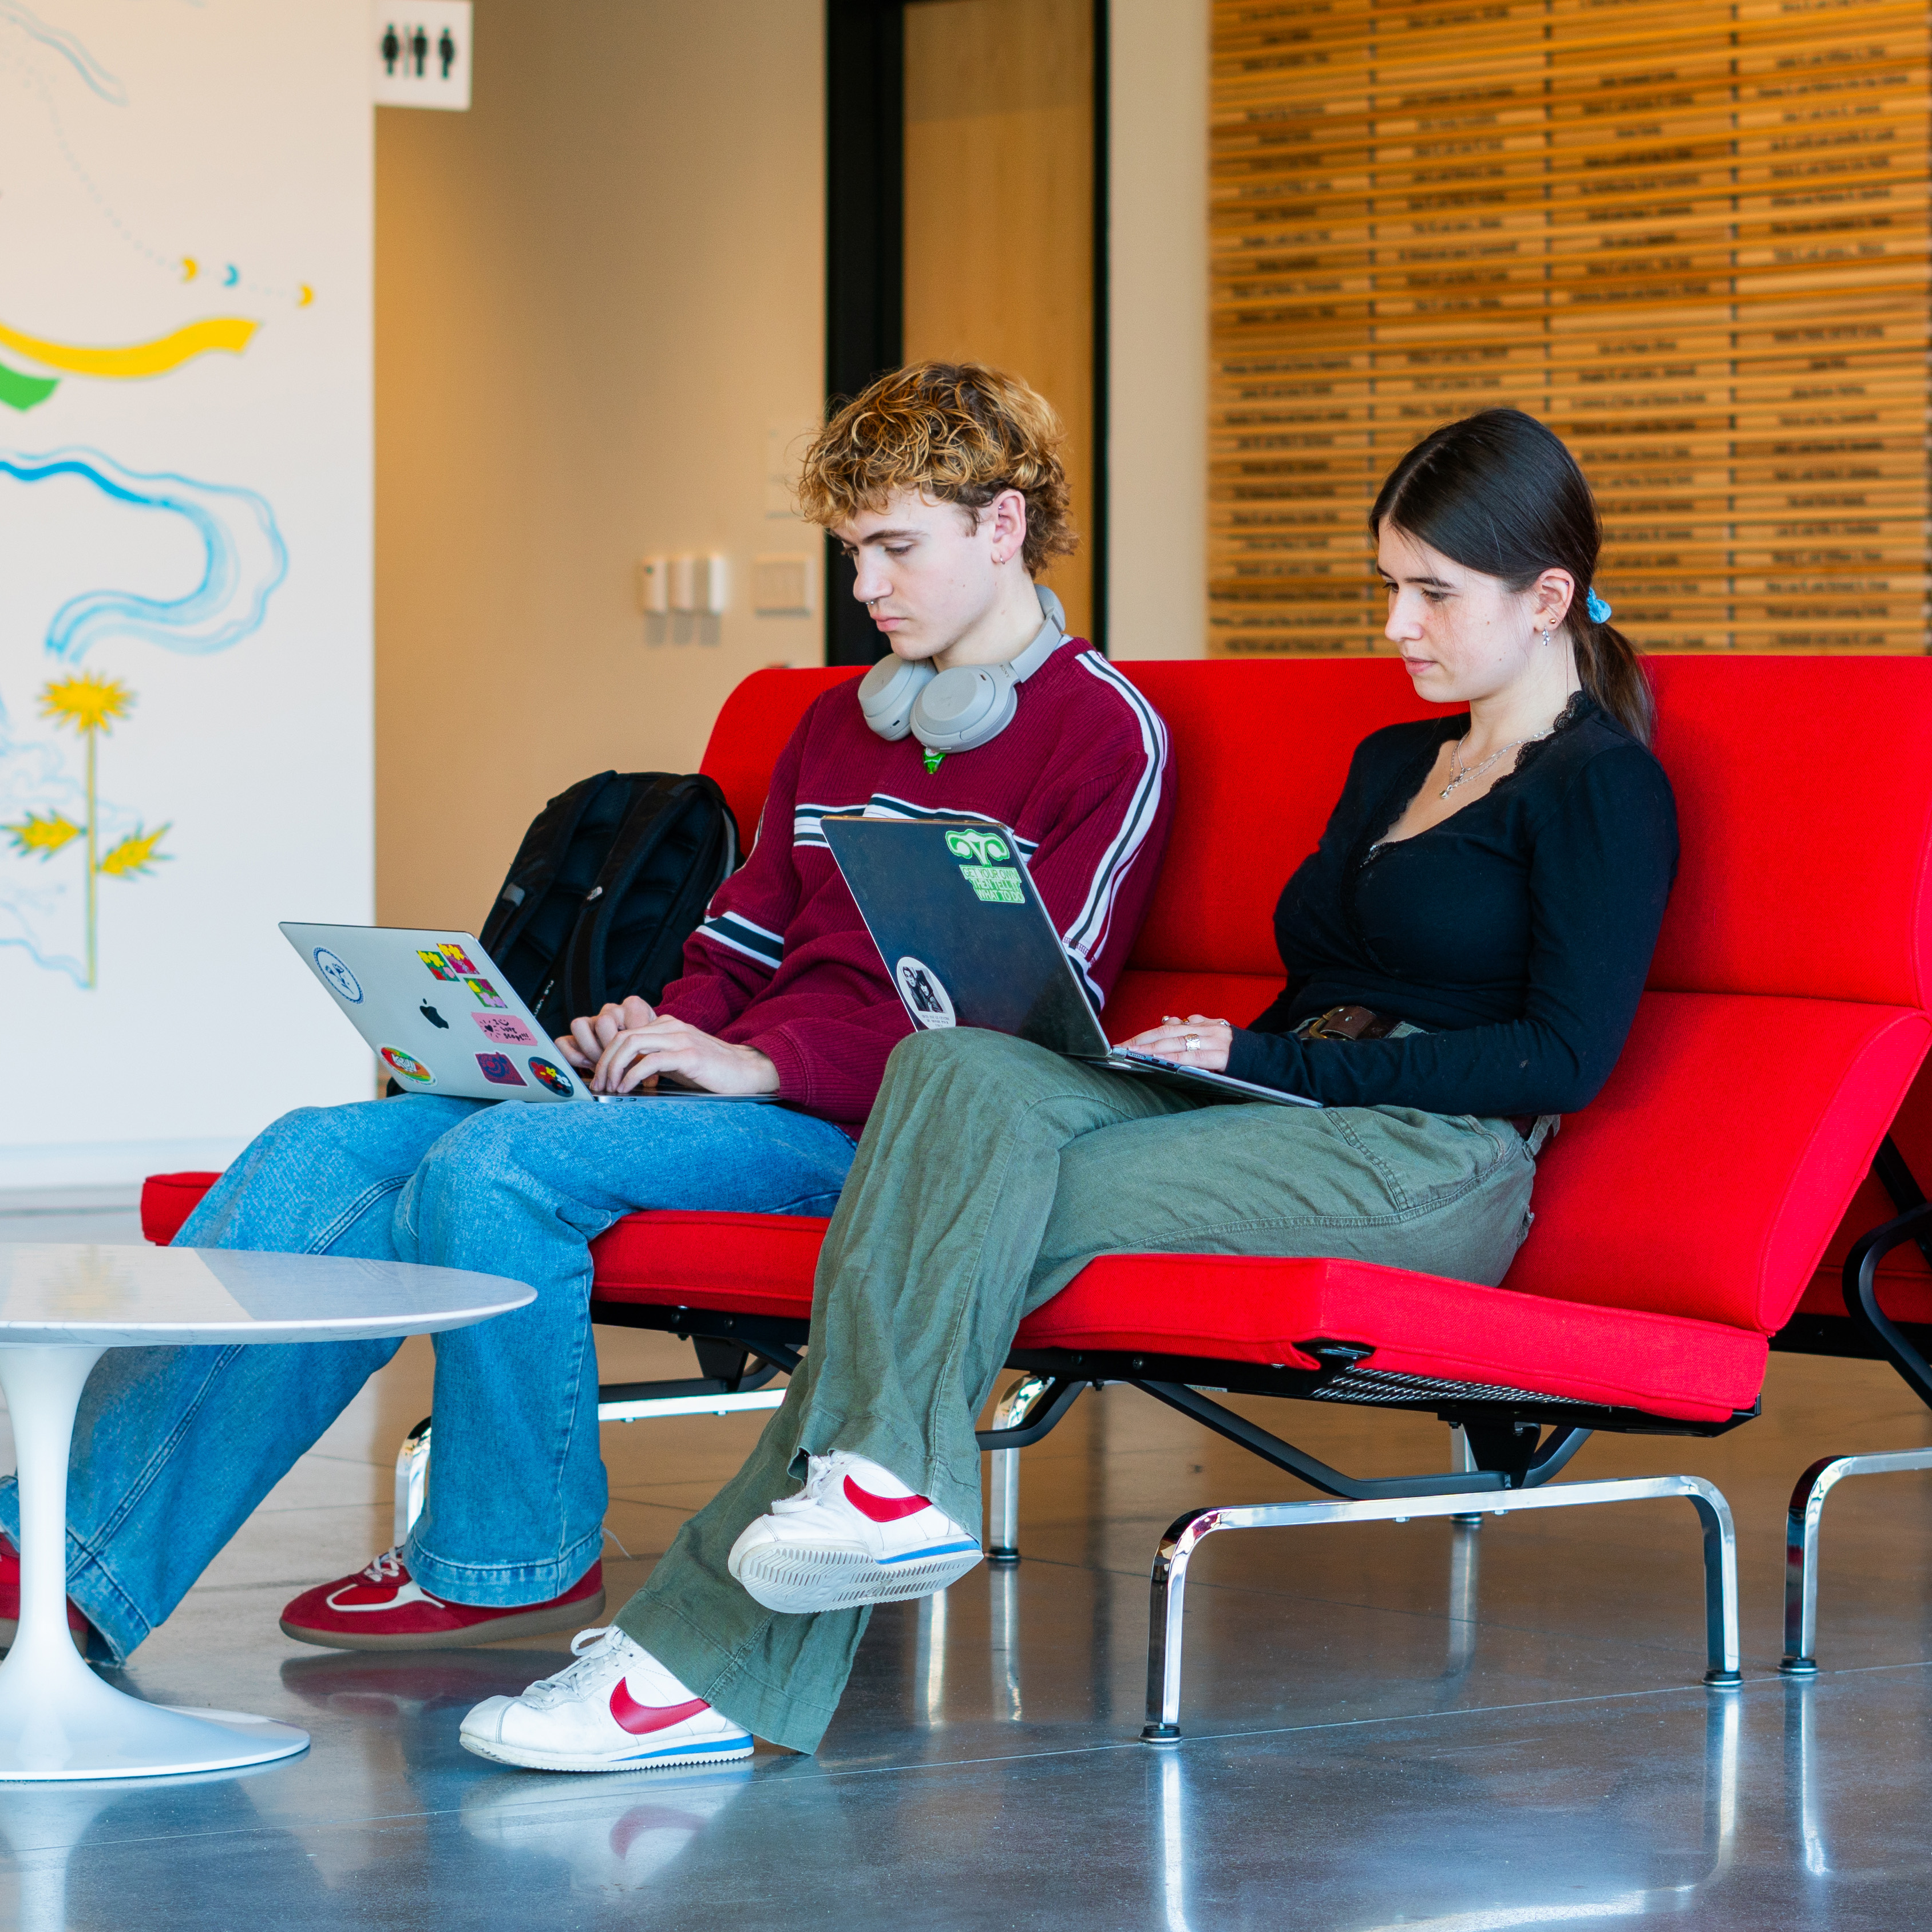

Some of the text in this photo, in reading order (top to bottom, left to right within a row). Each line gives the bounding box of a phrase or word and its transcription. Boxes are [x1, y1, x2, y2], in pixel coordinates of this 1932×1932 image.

[963, 868, 978, 877] GET
[977, 869, 999, 878] YOUR
[971, 878, 993, 889] THEN
[989, 880, 1013, 890] TELL
[976, 889, 1023, 901] WHAT TO DO
